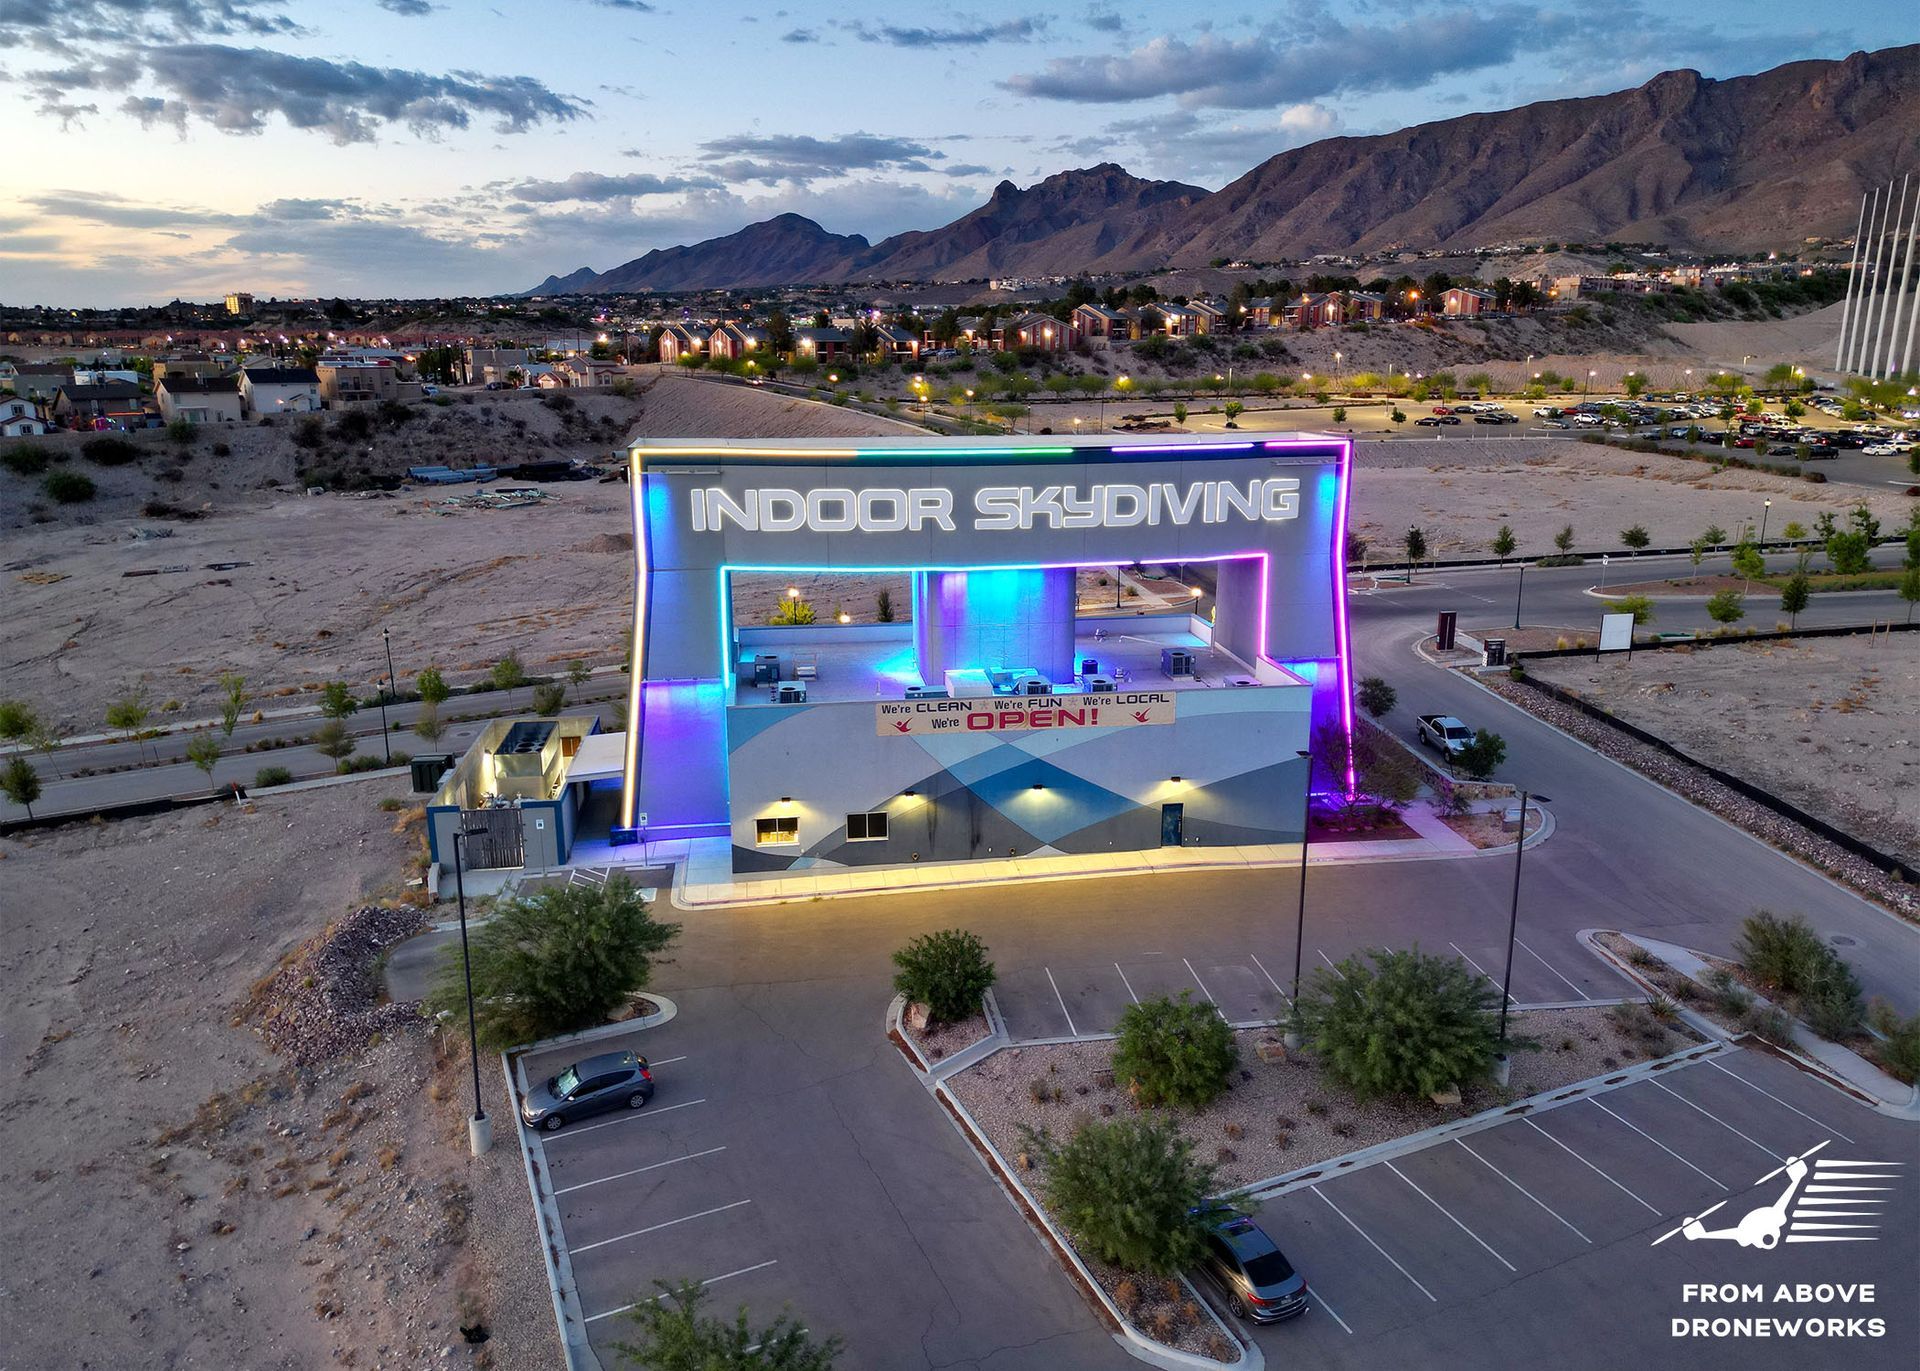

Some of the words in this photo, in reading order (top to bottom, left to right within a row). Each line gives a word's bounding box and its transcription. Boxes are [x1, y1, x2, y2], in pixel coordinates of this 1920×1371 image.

[689, 487, 957, 532] INDOOR
[974, 477, 1301, 530] SKYDIVING
[882, 704, 911, 714] We're
[916, 701, 972, 712] CLEAN
[994, 700, 1023, 709] We're
[1028, 698, 1062, 708] FUN
[1083, 696, 1111, 706] We're
[1116, 694, 1170, 704] LOCAL
[931, 718, 960, 729] We're
[966, 708, 1098, 730] OPEN!
